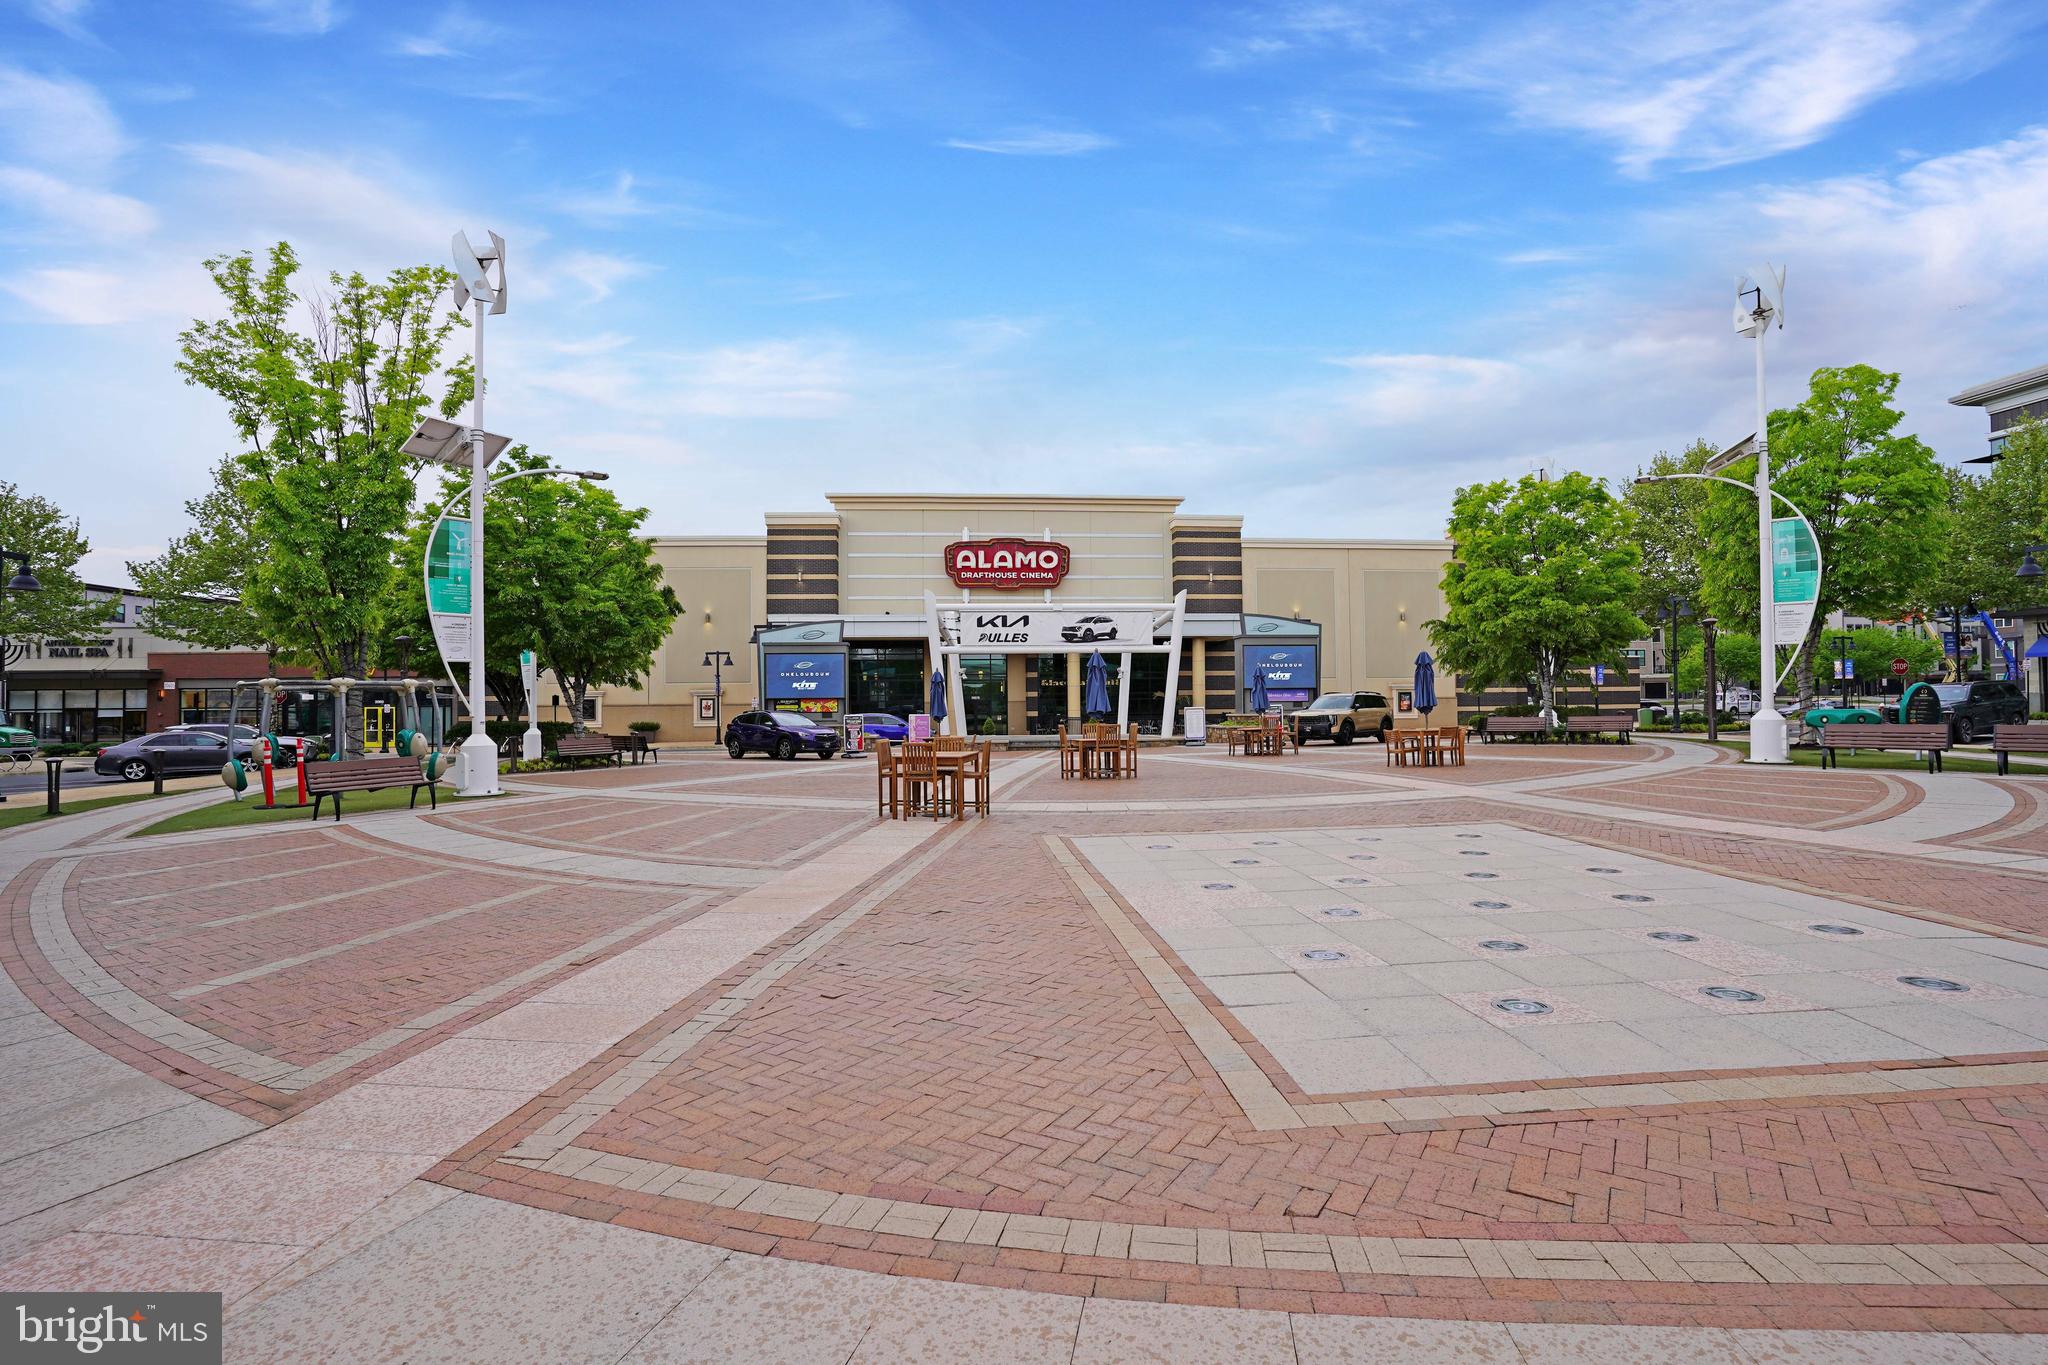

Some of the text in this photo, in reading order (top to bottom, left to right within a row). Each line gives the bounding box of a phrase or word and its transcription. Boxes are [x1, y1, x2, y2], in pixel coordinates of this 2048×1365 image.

[956, 550, 1059, 569] ALAMO
[961, 571, 1054, 579] DRAFTHOUSE CINEMA
[976, 615, 1030, 628] KIA
[978, 632, 1029, 643] DULLES
[48, 647, 110, 658] NAIL SPA
